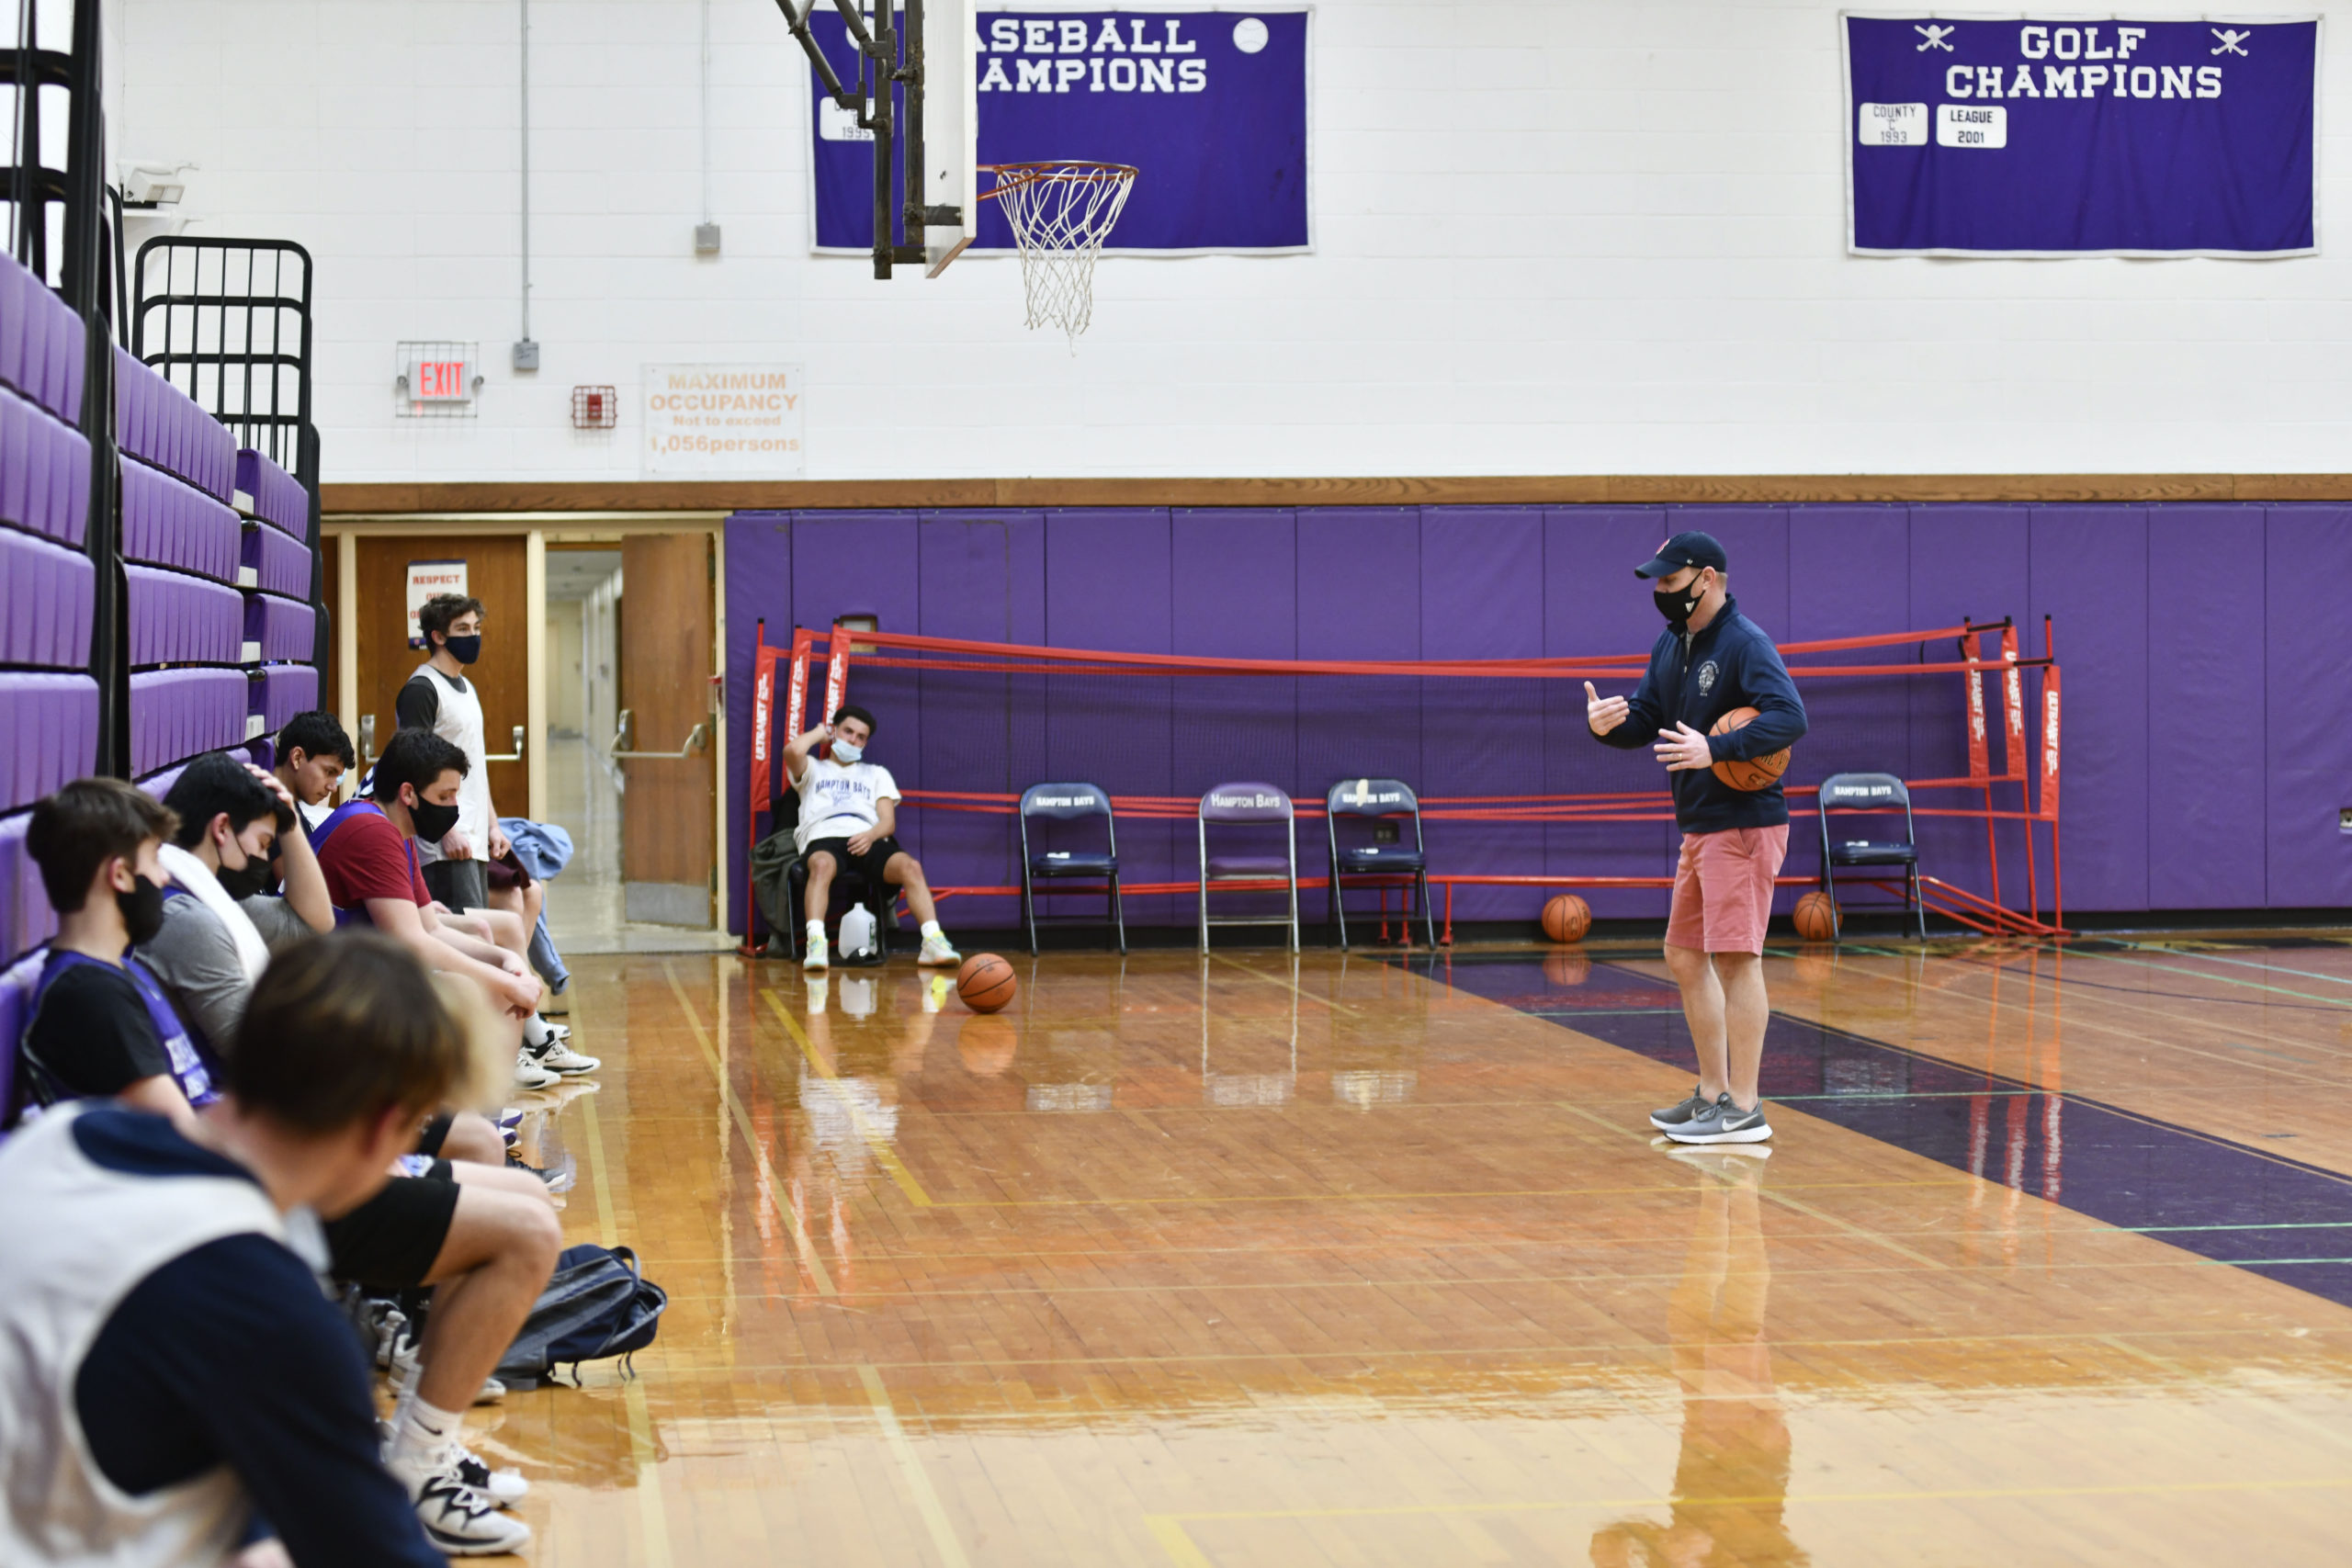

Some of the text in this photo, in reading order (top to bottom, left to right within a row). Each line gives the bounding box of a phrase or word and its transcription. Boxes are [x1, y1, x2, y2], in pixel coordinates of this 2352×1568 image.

[977, 18, 1196, 53] SEBALL
[2021, 26, 2146, 60] GOLF
[978, 58, 1206, 93] AMPIONS
[1946, 64, 2222, 98] CHAMPIONS
[1873, 106, 1917, 118] COUNTY
[1951, 109, 1993, 123] LEAGUE
[1881, 131, 1907, 143] 1993
[1958, 130, 1984, 143] 2001
[420, 361, 464, 397] EXIT
[668, 374, 786, 389] MAXIMUM
[650, 394, 797, 411] OCCUPANCY
[673, 415, 781, 426] Not to exceed
[413, 575, 460, 585] RESPECT
[816, 780, 850, 795] HAMPTON
[1834, 785, 1869, 796] HAMPTON
[1035, 796, 1072, 807] HAMPTON
